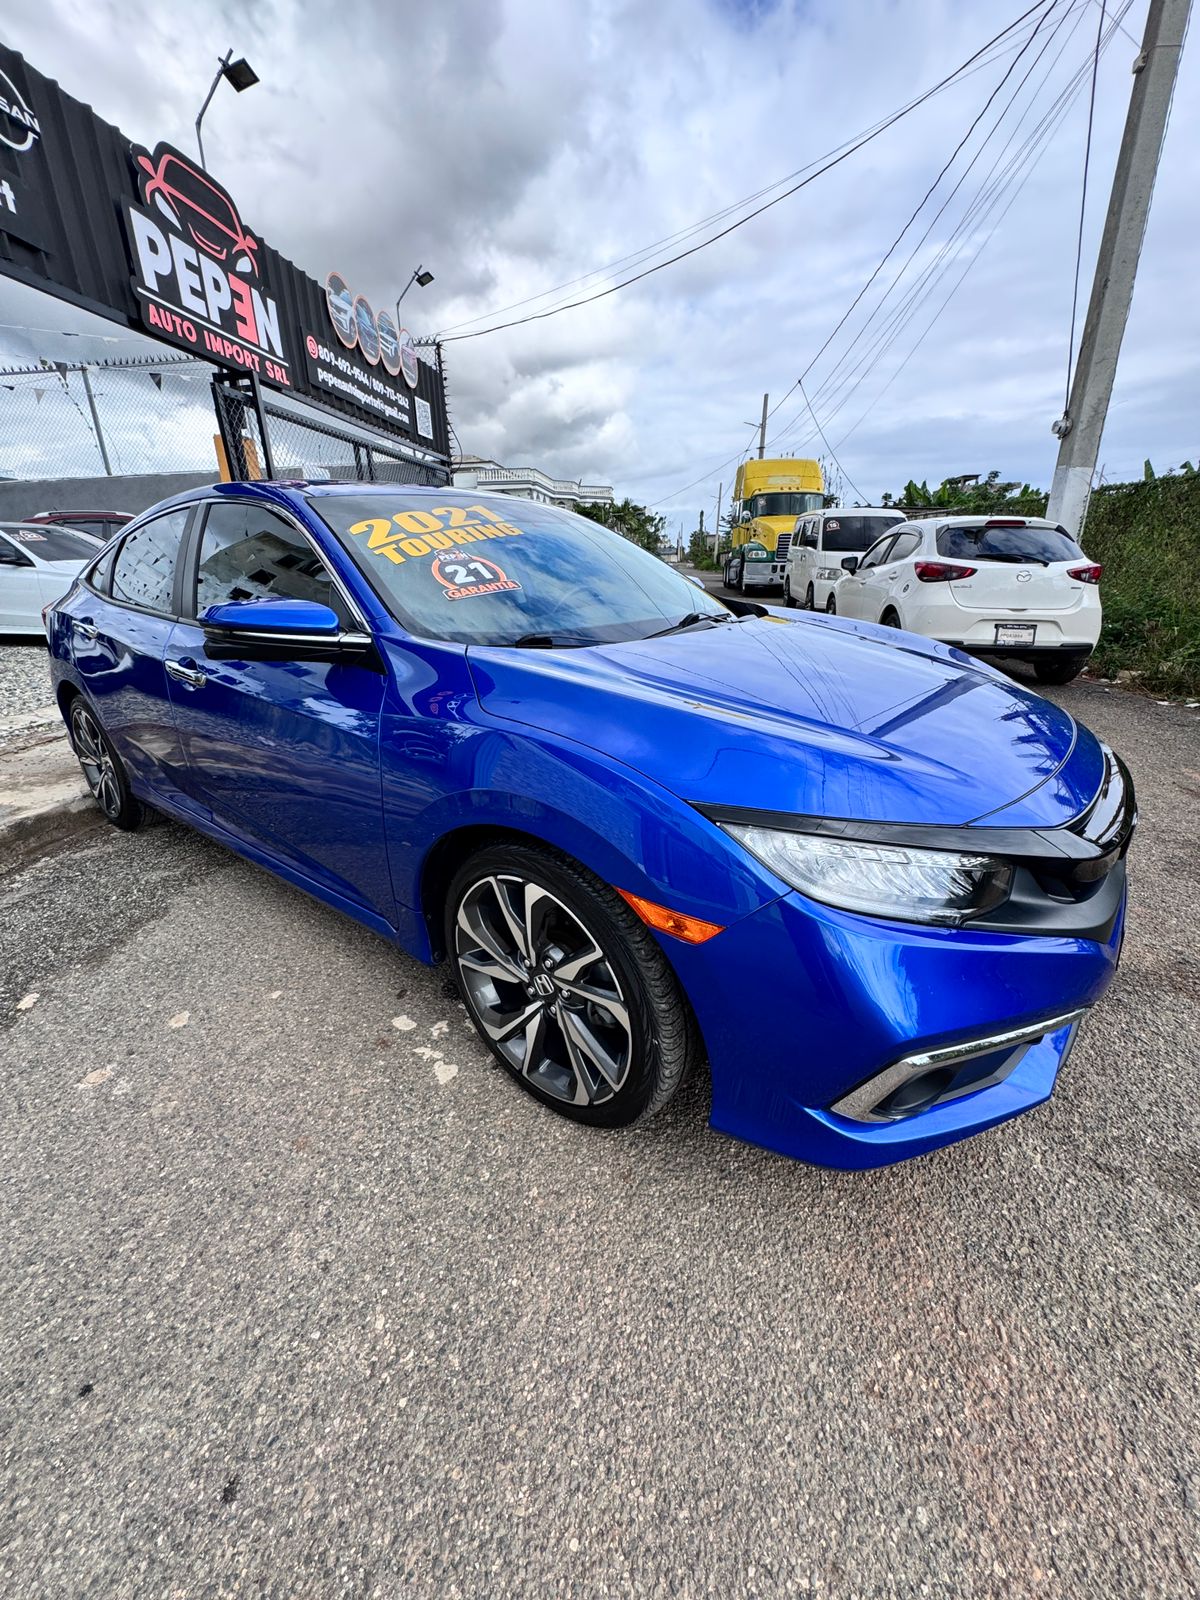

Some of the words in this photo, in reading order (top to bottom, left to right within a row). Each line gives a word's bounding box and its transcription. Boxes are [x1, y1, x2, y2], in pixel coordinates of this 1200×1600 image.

[129, 207, 284, 358] PEPEN
[149, 304, 197, 343] AUTO
[204, 330, 260, 373] IMPORT
[265, 360, 290, 386] SRL
[350, 505, 504, 549] 2021
[374, 521, 524, 565] TOURING
[444, 562, 494, 584] 21
[447, 581, 518, 598] GARANTIA
